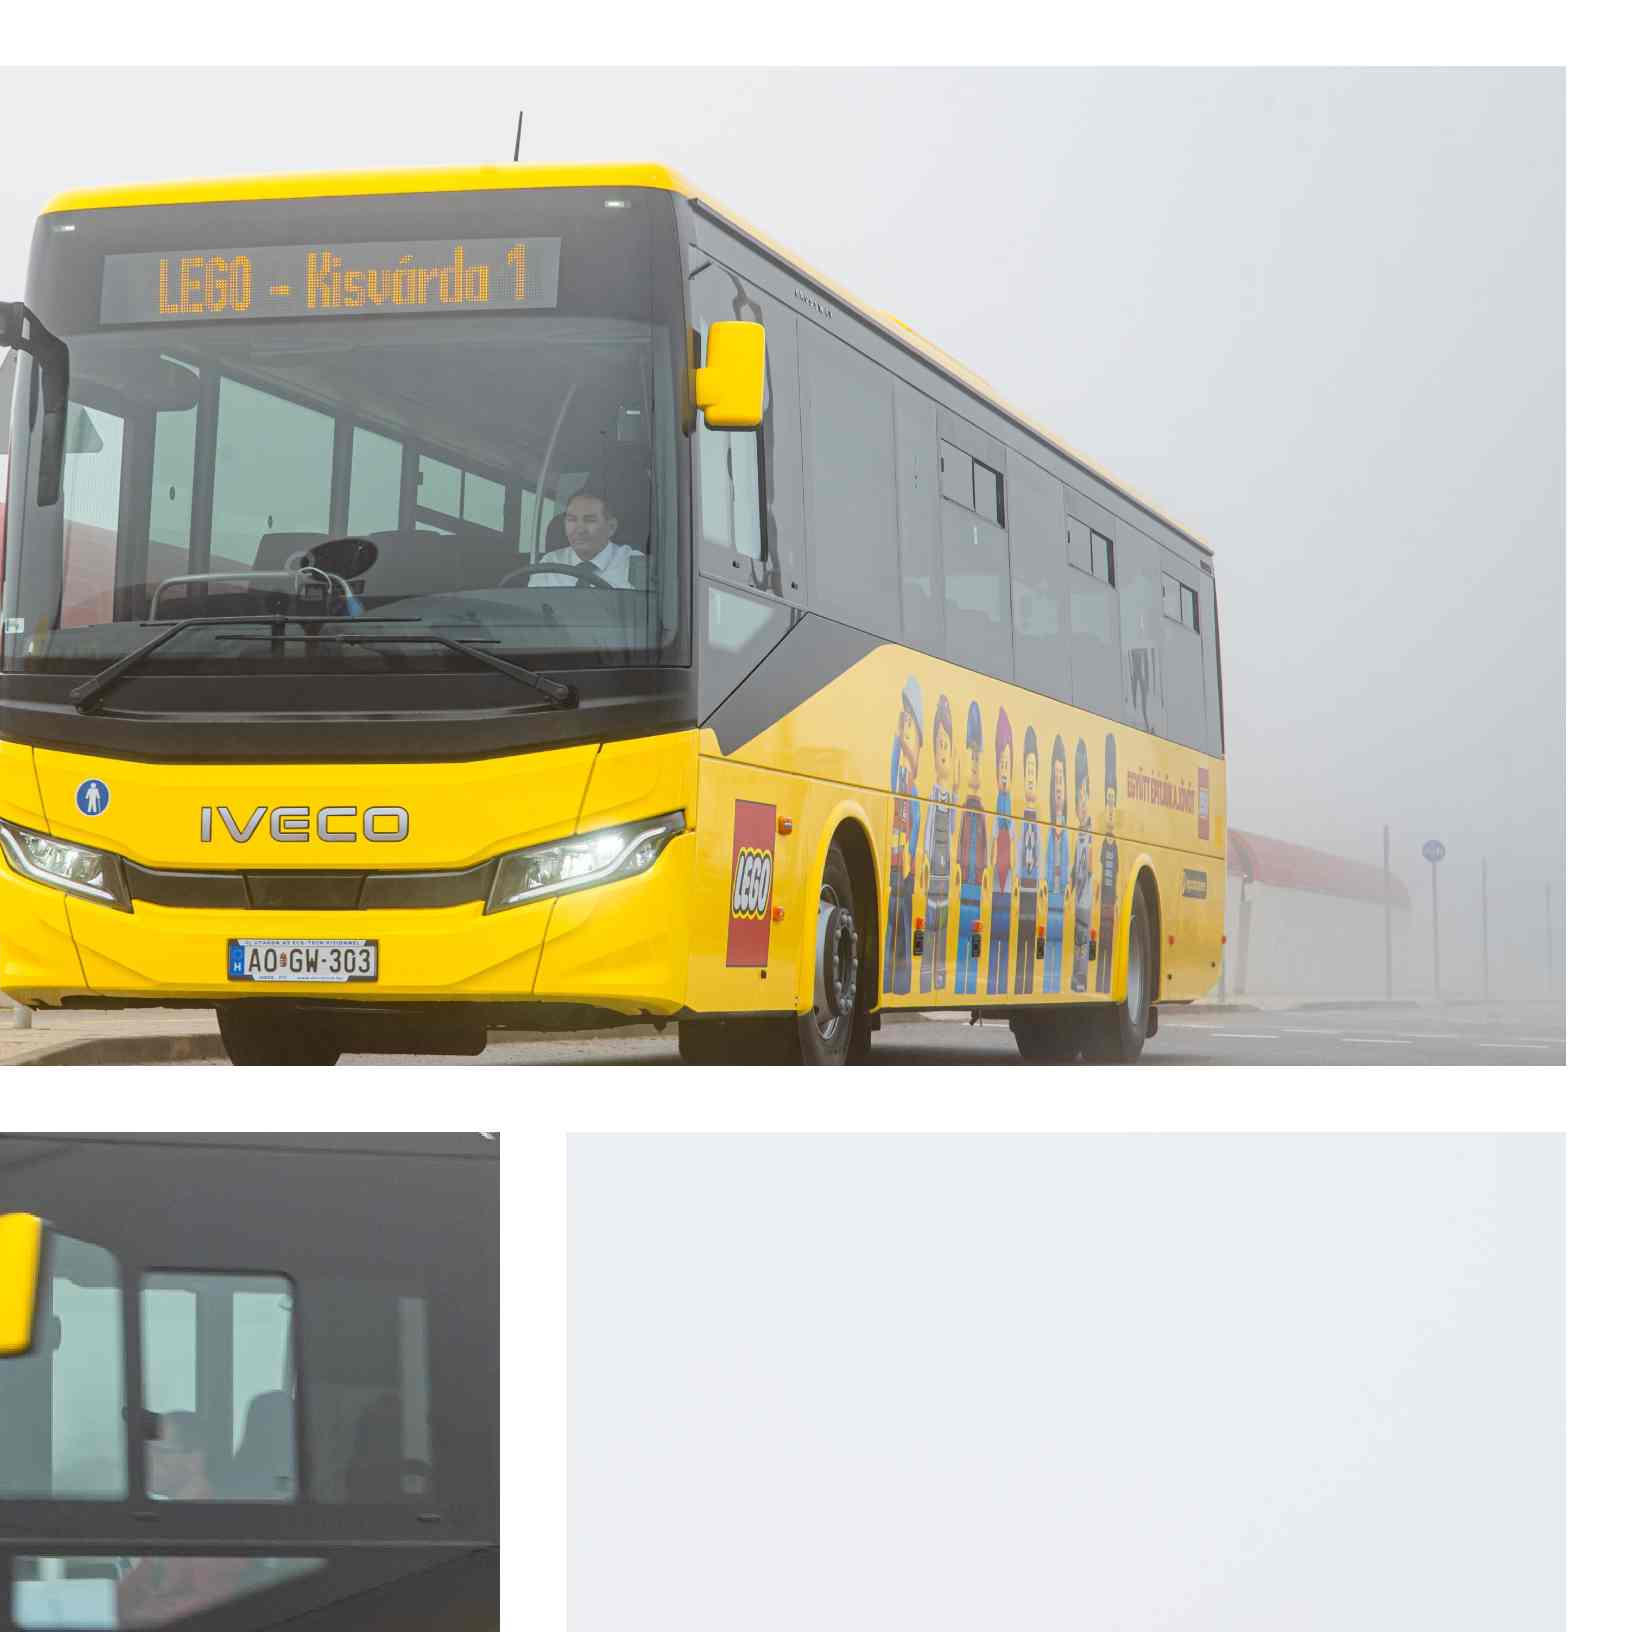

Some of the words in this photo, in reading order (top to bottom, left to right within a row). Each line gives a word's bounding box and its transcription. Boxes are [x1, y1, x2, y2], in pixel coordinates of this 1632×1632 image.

[159, 255, 252, 314] LEGO
[306, 241, 489, 309] Kisvárda
[504, 242, 529, 300] 1
[200, 806, 410, 843] IVECO
[732, 850, 772, 917] LEGO
[248, 948, 277, 972] AO
[289, 948, 370, 973] GW-303
